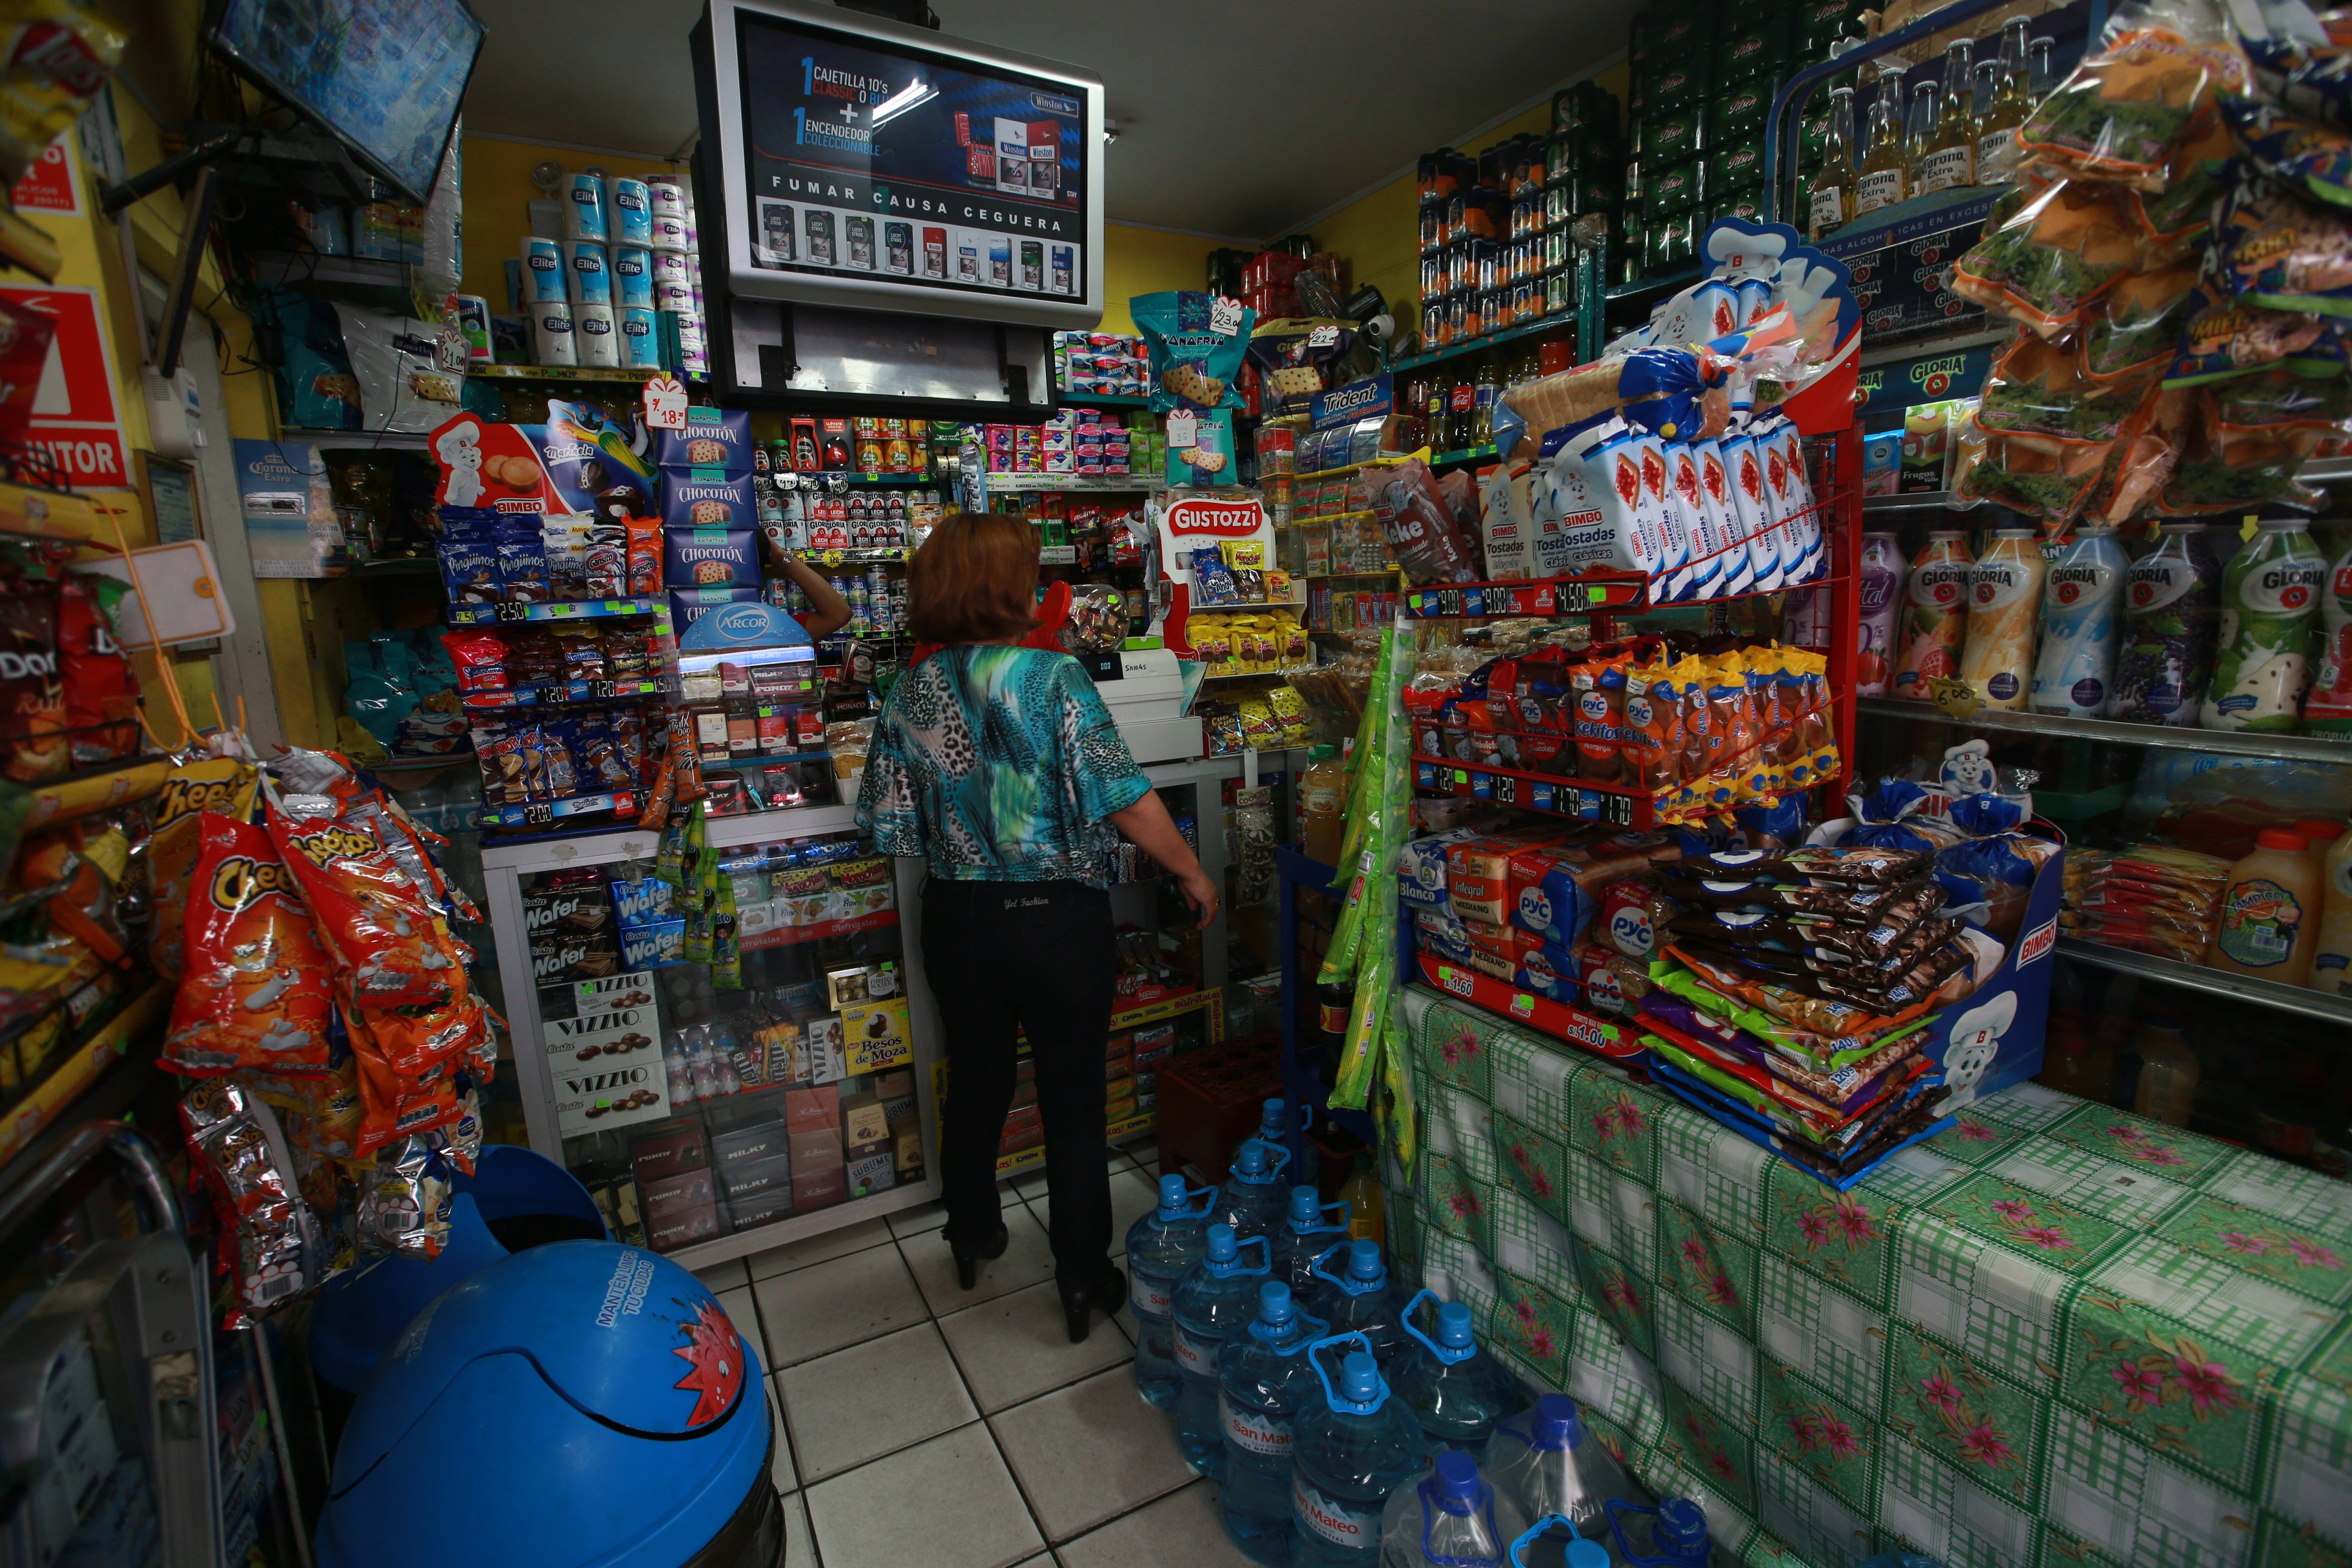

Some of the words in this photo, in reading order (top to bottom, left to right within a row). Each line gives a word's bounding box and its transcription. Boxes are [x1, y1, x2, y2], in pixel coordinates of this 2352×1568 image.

[1814, 0, 1848, 22] Pilsen
[1733, 39, 1762, 59] Pilsen
[802, 56, 814, 95] 1
[814, 67, 865, 89] CAJETILLA
[868, 78, 888, 94] 10's
[812, 81, 857, 100] CLASSIC
[1035, 95, 1062, 110] Winston
[1729, 95, 1757, 115] Pilsen
[794, 107, 805, 145] 1
[806, 120, 870, 142] ENCENDEDOR
[805, 133, 881, 156] COLECCIONABLE
[1004, 143, 1025, 155] Winston
[1033, 148, 1052, 158] Winston
[1727, 151, 1756, 170] Pilsen
[1928, 167, 1953, 179] Extra
[576, 191, 596, 203] Elite
[619, 195, 641, 207] Elite
[1861, 188, 1885, 199] Extra
[772, 175, 855, 199] FUMAR
[873, 192, 948, 214] CAUSA
[964, 207, 1061, 231] CEGUERA
[1930, 216, 1943, 226] EN
[1911, 232, 1950, 256] GLORIA
[532, 256, 555, 268] Elite
[577, 259, 599, 270] Elite
[619, 263, 640, 273] Elite
[1867, 304, 1903, 324] GLORIA
[1910, 355, 1965, 381] GLORIA
[1324, 383, 1377, 414] Trident
[1316, 416, 1330, 424] EXISTEN
[1343, 406, 1358, 415] FORMAS
[545, 444, 593, 459] Marinela
[248, 462, 299, 475] Corona
[1903, 471, 1935, 480] Frugos
[264, 473, 291, 483] Extra
[676, 486, 742, 504] CHOCOTÓN
[497, 501, 542, 512] BIMBO
[1564, 510, 1603, 527] BIMBO
[1492, 525, 1518, 538] BIMBO
[1562, 528, 1615, 545] Tostadas
[1659, 523, 1669, 547] BIMBO
[1662, 510, 1677, 553] Tostadas
[1487, 541, 1524, 554] Tostadas
[1632, 532, 1643, 557] BIMBO
[1637, 518, 1653, 563] Tostadas
[589, 552, 613, 569] Gansito
[679, 547, 745, 564] CHOCOTÓN
[1573, 549, 1613, 562] Clásicas
[449, 553, 495, 576] Pingüinos
[500, 554, 544, 576] Pingüinos
[631, 560, 654, 575] Gansito
[1969, 571, 2011, 587] GLORIA
[2051, 569, 2097, 586] GLORIA
[2126, 568, 2172, 586] GLORIA
[2263, 571, 2324, 589] GLORIA
[719, 616, 766, 629] ARCOR
[836, 702, 865, 711] MONACO
[1575, 719, 1621, 741] Kekitos
[1584, 742, 1611, 753] Naranja
[730, 853, 768, 870] OREO
[1512, 863, 1536, 876] Blanco
[841, 863, 882, 885] Morochas
[783, 873, 824, 894] Morochas
[1399, 882, 1435, 901] Blanco
[1455, 881, 1484, 898] Integral
[619, 886, 673, 918] Wafer
[2229, 884, 2284, 911] TAMPICO
[1456, 901, 1489, 914] MEDIANO
[832, 918, 877, 931] Disfrútalas
[626, 931, 650, 940] Costa
[2021, 922, 2055, 961] BIMBO
[625, 930, 681, 964] Wafer
[1475, 951, 1506, 968] MEDIANO
[557, 1010, 640, 1035] VIZZIO
[1122, 1013, 1143, 1022] Casino
[1573, 1012, 1588, 1024] NEGRITO
[1143, 1028, 1168, 1043] Casino
[548, 1043, 575, 1054] Costa
[861, 1036, 902, 1054] Besos
[855, 1055, 868, 1064] de
[871, 1046, 907, 1062] Moza
[1140, 1049, 1167, 1062] Casino
[566, 1067, 648, 1094] VIZZIO
[557, 1102, 584, 1113] Costa
[728, 1144, 766, 1159] MILKY
[1016, 1152, 1039, 1163] Casino
[852, 1155, 890, 1177] SUBLIME
[874, 1170, 892, 1183] BOX
[730, 1178, 769, 1193] MILKY
[734, 1211, 773, 1226] MILKY
[618, 1250, 638, 1276] LIMPIA
[624, 1296, 640, 1314] TU
[633, 1261, 653, 1298] CIUDAD
[1233, 1419, 1257, 1440] San
[1311, 1506, 1359, 1534] Mateo
[1304, 1516, 1344, 1543] MANANTIAL
